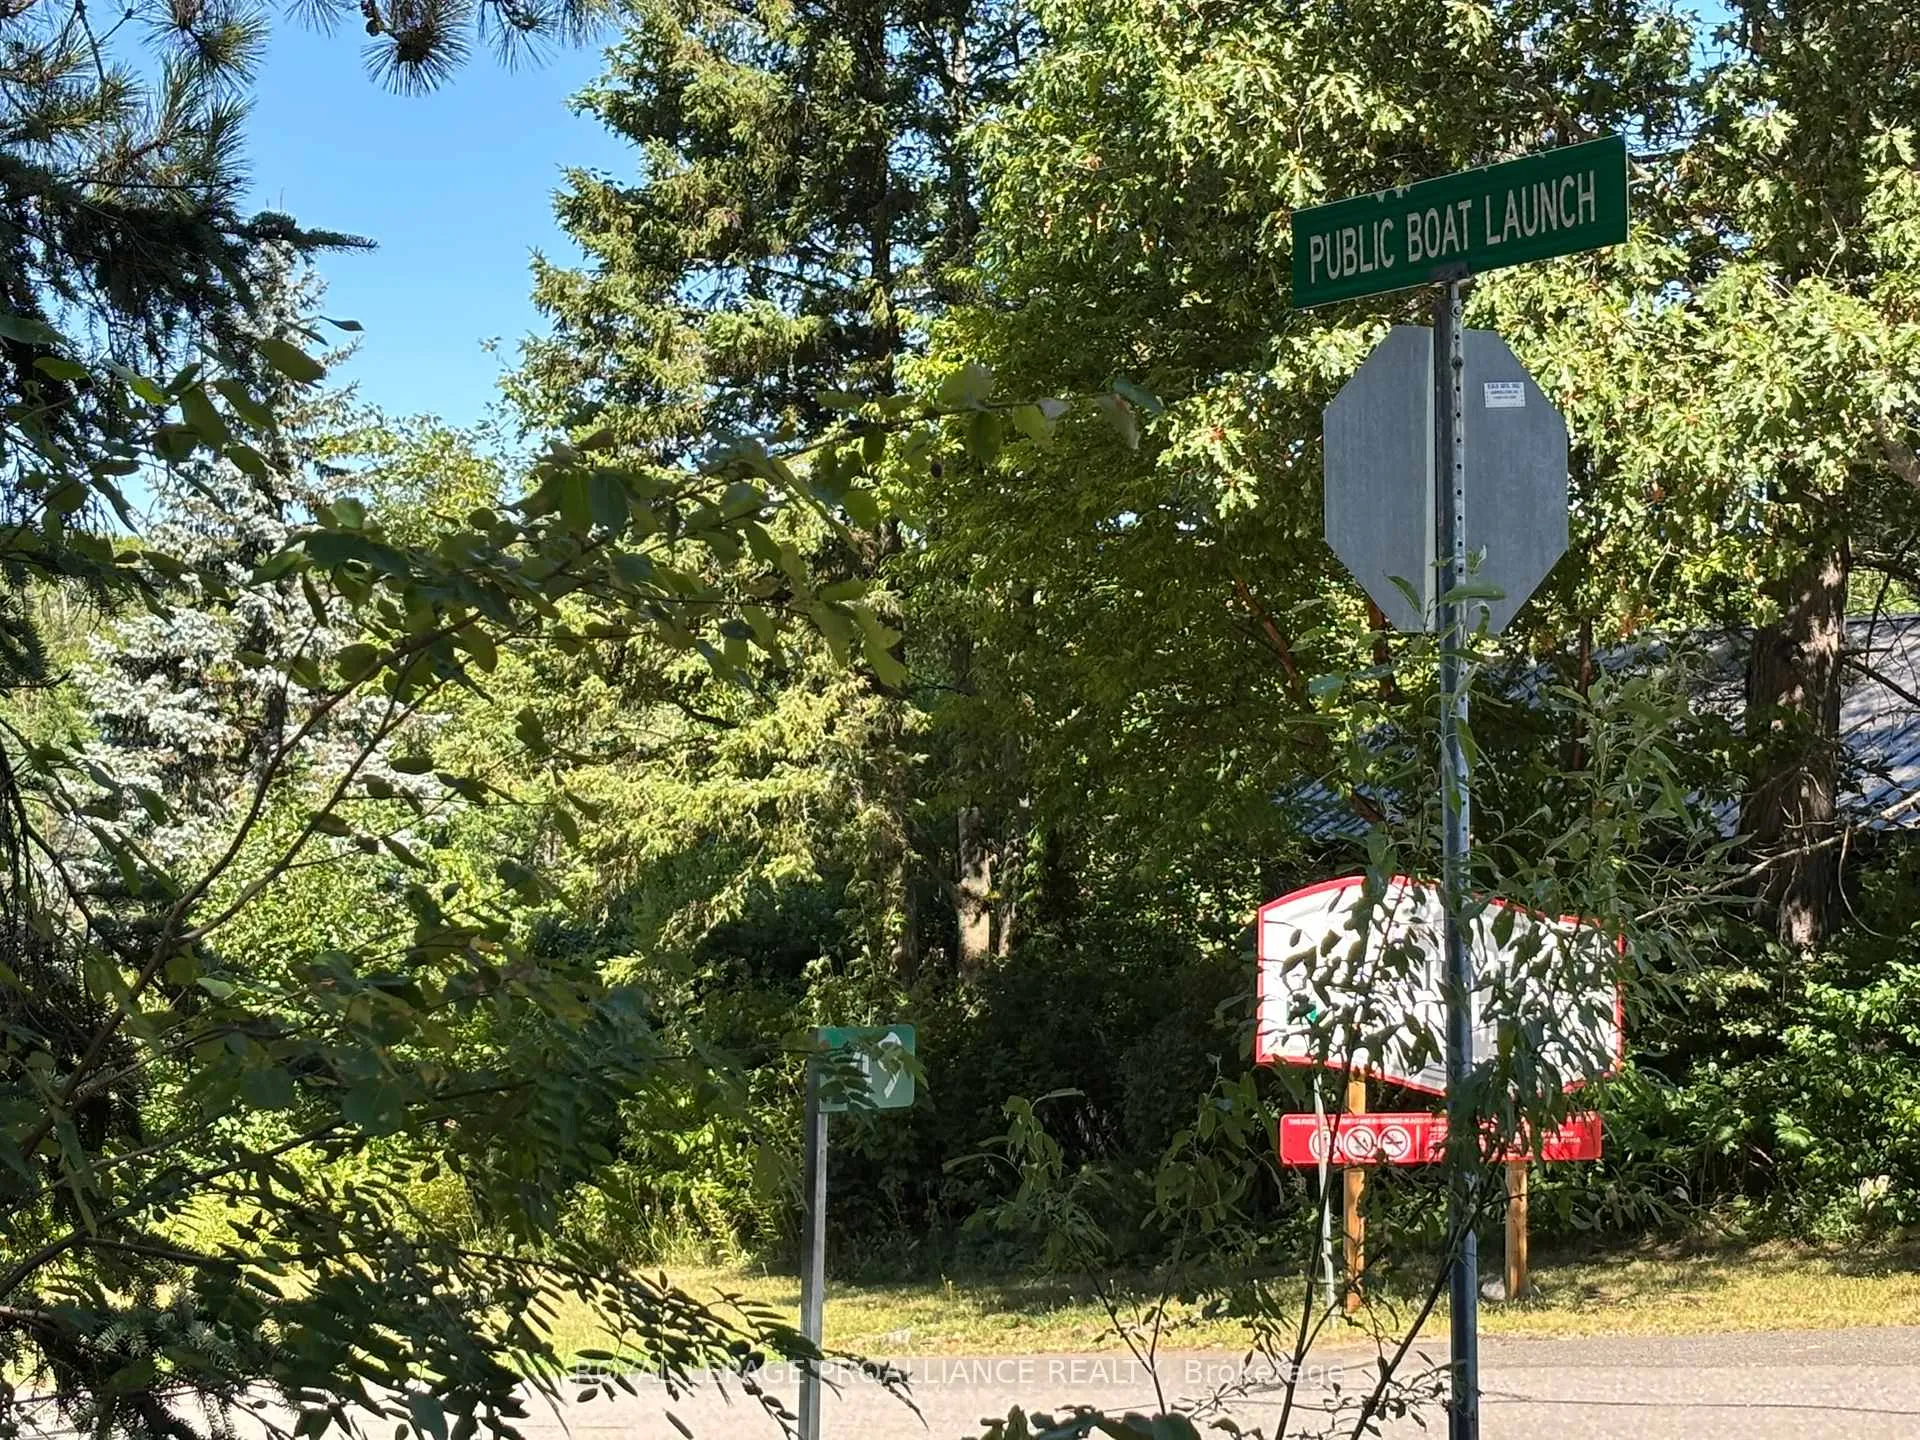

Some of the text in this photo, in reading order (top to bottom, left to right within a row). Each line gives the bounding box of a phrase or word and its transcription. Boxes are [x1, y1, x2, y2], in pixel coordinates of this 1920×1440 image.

[1309, 170, 1596, 283] PUBLIC BOAT LAUNCH
